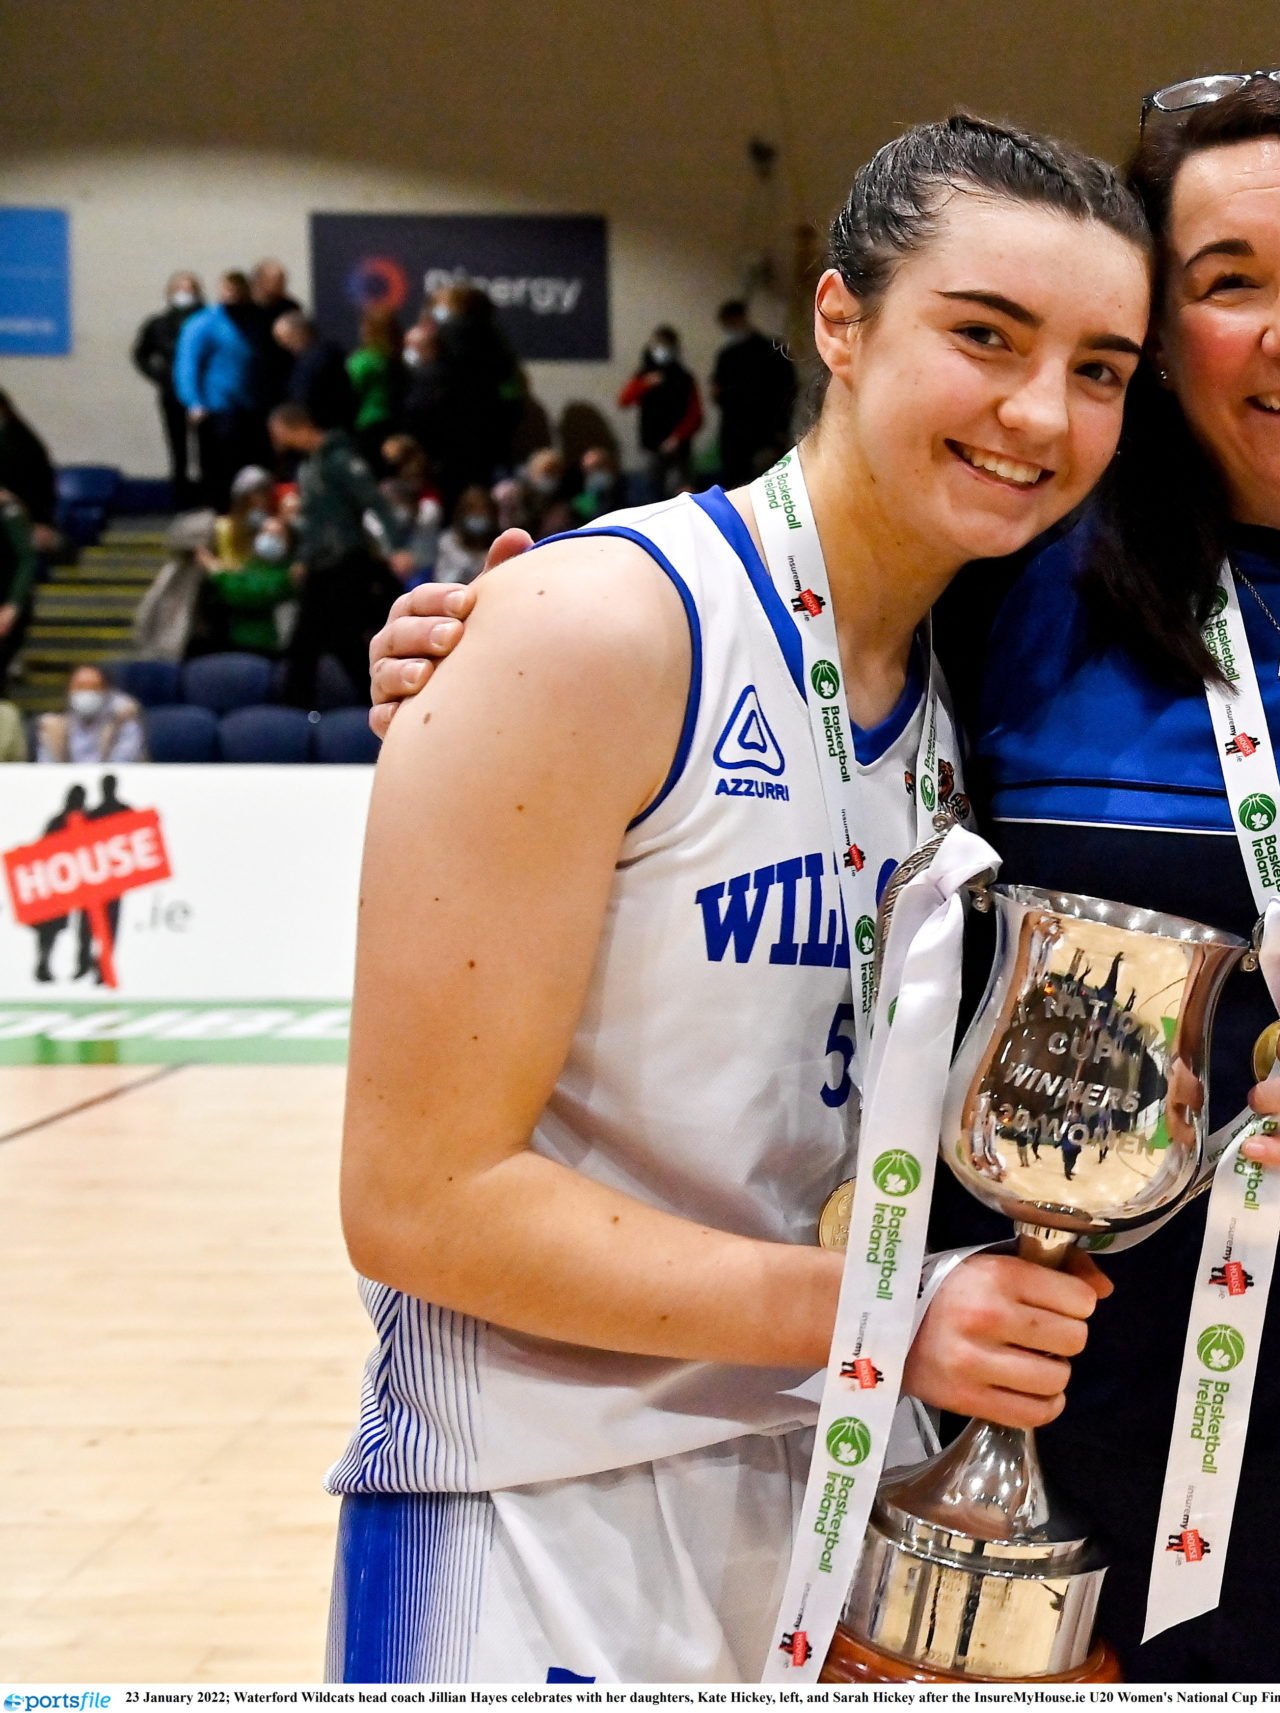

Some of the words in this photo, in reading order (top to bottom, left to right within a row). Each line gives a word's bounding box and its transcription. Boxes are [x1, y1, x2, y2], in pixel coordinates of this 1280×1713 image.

[776, 472, 803, 530] Basketball
[1215, 619, 1240, 682] Basketball
[821, 706, 839, 758] Ireland
[830, 705, 852, 783] Basketball
[1224, 703, 1237, 736] insuremy
[714, 777, 790, 802] AZZURRI
[13, 826, 165, 906] HOUSE
[1251, 838, 1275, 888] Ireland
[820, 1003, 856, 1108] 5
[1048, 1031, 1115, 1064] CUP
[1004, 1061, 1141, 1113] WINNERS
[1244, 1119, 1279, 1211] Betball
[866, 1202, 885, 1265] Ireland
[876, 1205, 907, 1301] Basketball
[1228, 1263, 1242, 1294] HOUSE
[1190, 1377, 1214, 1440] Ireland
[1201, 1381, 1230, 1475] Basketball
[814, 1470, 841, 1535] Ireland
[818, 1473, 856, 1575] Basketball
[1180, 1484, 1195, 1530] insuremy
[1185, 1531, 1199, 1562] HOUSE
